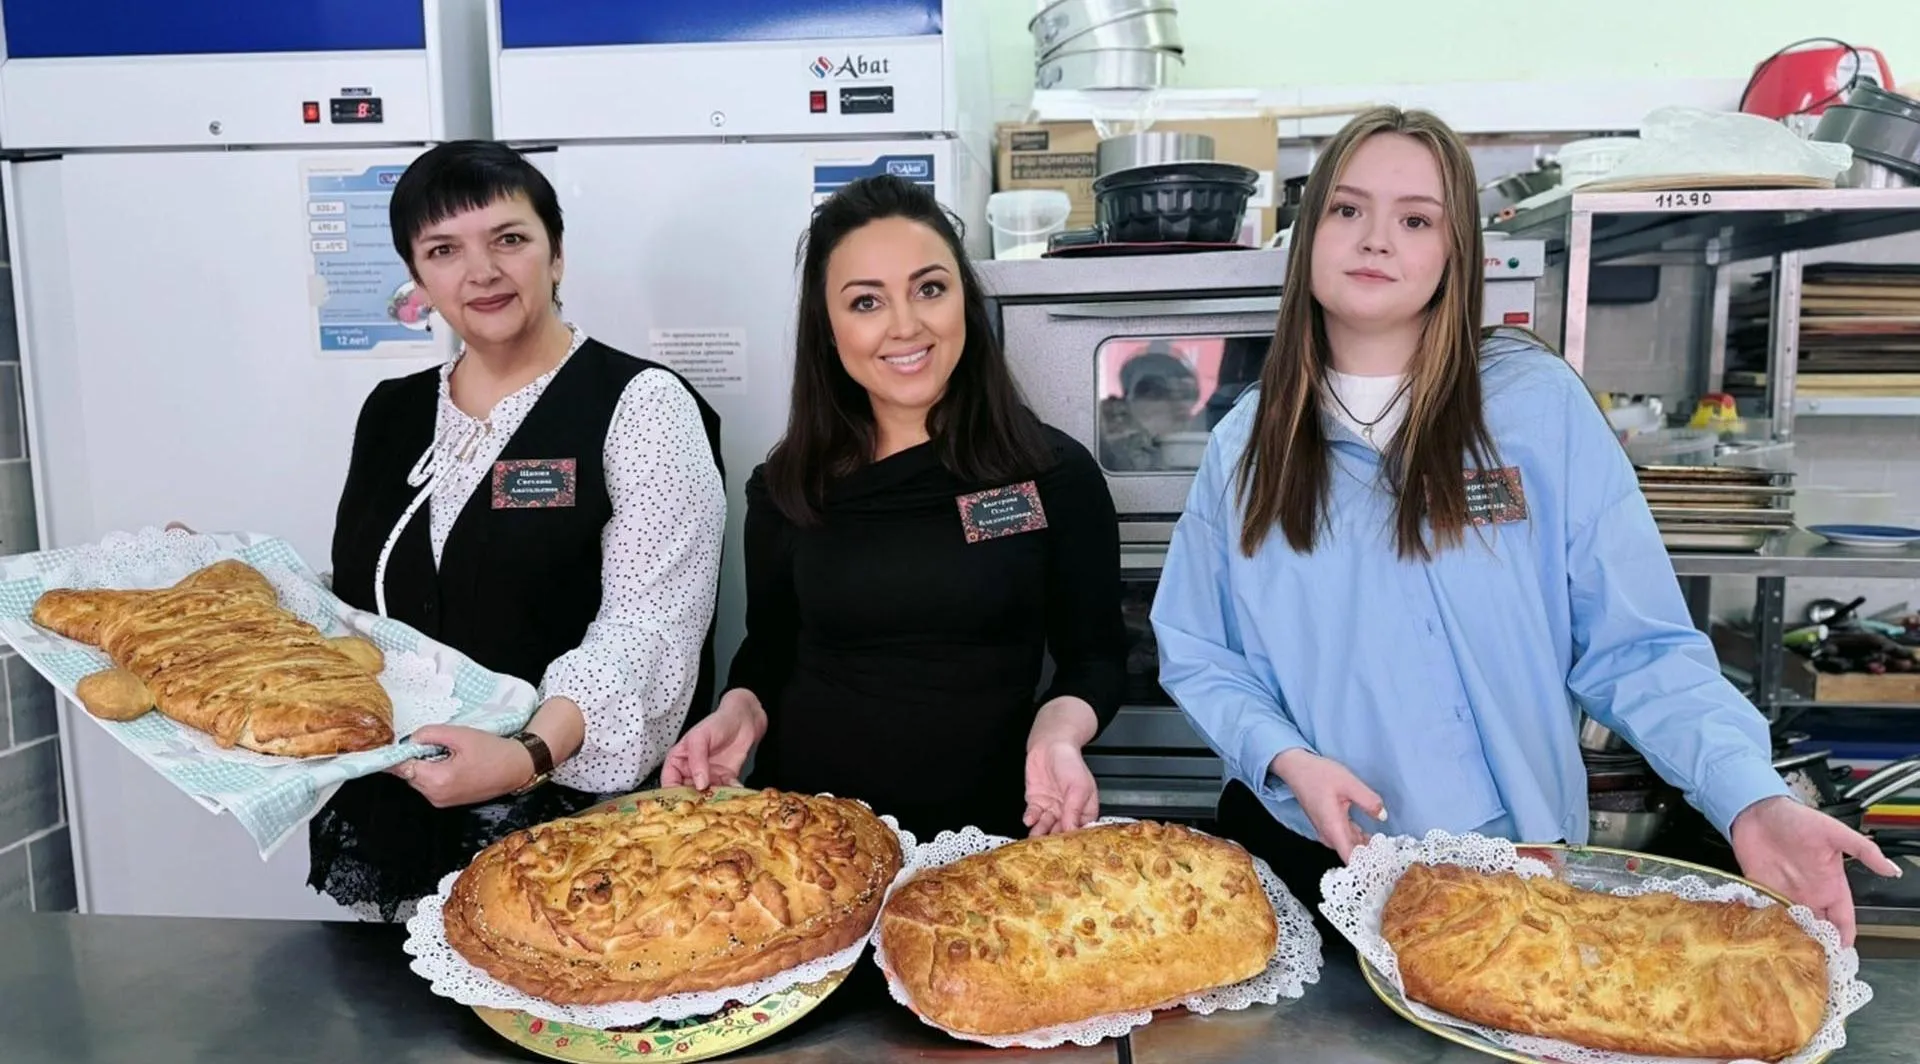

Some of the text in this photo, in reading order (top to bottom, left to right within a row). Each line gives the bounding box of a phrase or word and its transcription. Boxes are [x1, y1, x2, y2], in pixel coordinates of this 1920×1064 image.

[834, 54, 889, 78] Abat
[1039, 154, 1095, 165] КОМПАКТН
[1656, 192, 1712, 208] 11290
